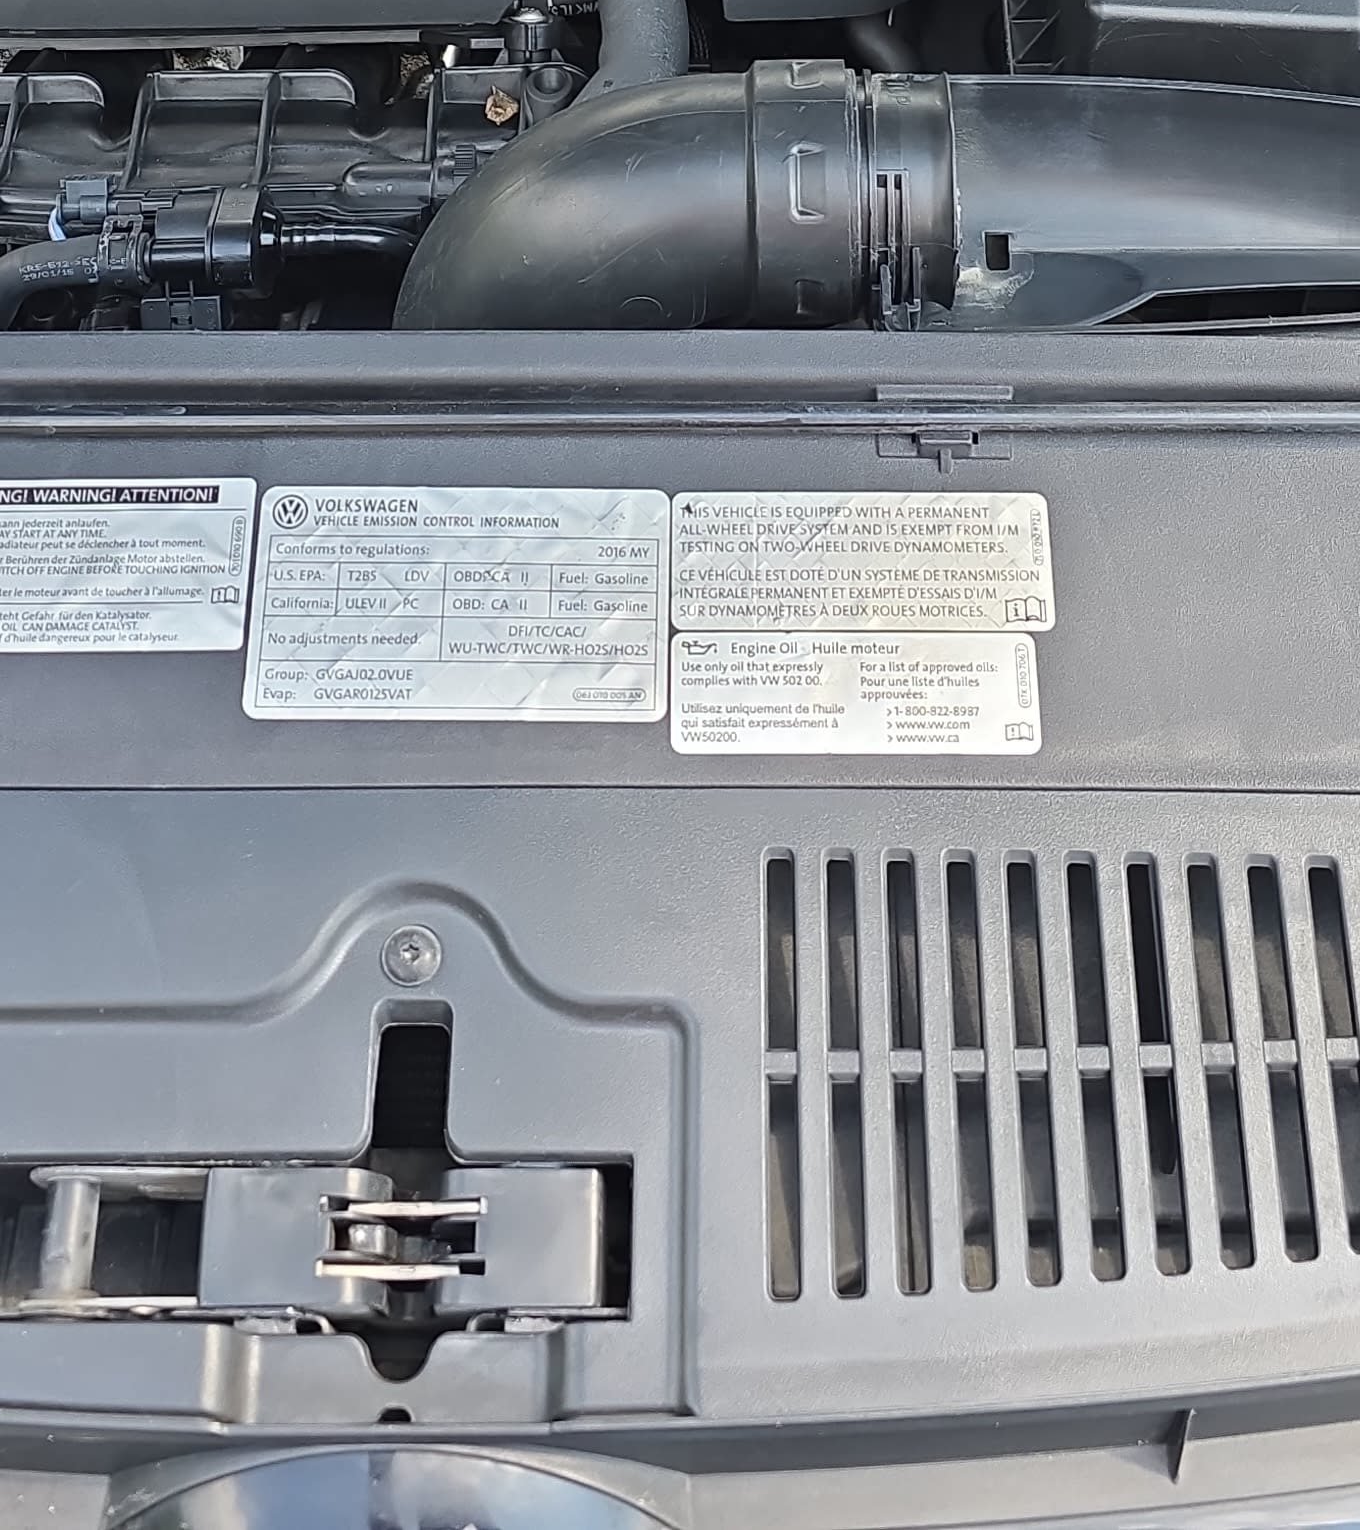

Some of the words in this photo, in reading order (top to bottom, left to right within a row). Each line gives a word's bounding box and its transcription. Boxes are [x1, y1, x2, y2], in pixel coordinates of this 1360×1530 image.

[33, 489, 116, 503] WARNING!
[119, 489, 213, 502] ATTENTION!
[315, 499, 418, 513] VOLKSWAGEN
[680, 506, 709, 518] THIS
[713, 506, 766, 518] VEHICLE
[771, 506, 782, 518] IS
[786, 506, 852, 520] EQUIPPED
[856, 507, 891, 518] WITH
[895, 507, 904, 518] A
[908, 507, 990, 518] PERMANENT
[314, 516, 359, 526] VEHICLE
[363, 516, 417, 527] EMISSION
[424, 516, 474, 528] CONTROL
[480, 518, 559, 529] INFORMATION
[13, 530, 40, 539] START
[43, 530, 56, 538] AT
[57, 529, 78, 538] ANY
[80, 529, 107, 538] TIME.
[680, 524, 753, 536] ALL-WHEEL
[757, 524, 795, 535] DRIVE
[800, 524, 848, 535] SYSTEM
[852, 524, 882, 536] AND
[886, 524, 897, 536] IS
[901, 524, 952, 536] EXEMPT
[956, 524, 993, 536] FROM
[997, 525, 1019, 536] I/M
[276, 543, 336, 555] Conforms
[340, 544, 352, 555] to
[355, 543, 430, 558] regulations:
[598, 546, 626, 558] 2016
[630, 547, 650, 559] MY
[680, 541, 734, 552] TESTING
[738, 541, 759, 552] ON
[763, 541, 848, 552] TWO-WHEEL
[851, 541, 891, 553] DRIVE
[894, 541, 1008, 553] DYNAMOMETERS.
[274, 570, 297, 581] U.S.
[300, 570, 325, 581] EPA:
[348, 570, 377, 581] T2B5
[405, 570, 429, 581] LDV
[559, 572, 588, 584] Fuel:
[595, 573, 649, 585] Gasoline
[680, 569, 695, 581] CE
[698, 567, 761, 581] VÉHICULE
[765, 570, 786, 581] EST
[790, 567, 825, 581] DOTÉ
[828, 569, 861, 581] D'UN
[923, 570, 941, 581] DE
[944, 570, 1040, 581] TRANSMISSION
[679, 585, 748, 599] INTÉGRALE
[751, 587, 829, 598] PERMANENT
[831, 587, 846, 598] ET
[849, 585, 905, 599] EXEMPTÉ
[908, 587, 961, 599] D'ESSAIS
[964, 587, 997, 599] D'I/M
[271, 597, 334, 610] California:
[345, 598, 376, 609] ULEV
[379, 598, 387, 609] II
[402, 598, 419, 610] PC
[453, 599, 485, 610] OBD:
[491, 599, 509, 610] CA
[519, 599, 527, 611] II
[558, 599, 587, 611] Fuel:
[593, 600, 648, 612] Gasoline
[680, 605, 705, 617] SUR
[709, 603, 816, 617] DYNAMOMÈTRES
[819, 603, 830, 616] À
[833, 605, 868, 617] DEUX
[872, 605, 916, 617] ROUES
[919, 605, 987, 617] MOTRICES.
[508, 625, 587, 638] DFI/TC/CAC/
[268, 633, 286, 645] No
[289, 633, 368, 647] adjustments
[371, 633, 421, 645] needed.
[449, 642, 648, 656] WU-TWC/TWC/WR-HO2S/HO2S
[731, 642, 776, 657] Engine
[780, 642, 797, 654] Oil
[812, 642, 847, 654] Huile
[851, 642, 900, 655] moteur
[681, 662, 701, 672] Use
[705, 662, 728, 674] only
[731, 662, 744, 672] oil
[747, 662, 769, 672] that
[772, 662, 823, 675] expressly
[860, 662, 877, 672] For
[879, 664, 886, 672] a
[889, 662, 905, 672] list
[908, 662, 920, 672] of
[923, 662, 973, 675] approved
[976, 662, 998, 672] oils:
[265, 669, 308, 682] Group:
[316, 669, 413, 680] GVGAJ02.0VUE
[681, 676, 730, 688] complies
[733, 676, 758, 686] with
[760, 676, 780, 686] VW
[783, 676, 802, 686] 502
[806, 676, 822, 686] 00.
[860, 677, 885, 687] Pour
[888, 678, 908, 687] une
[912, 677, 935, 687] liste
[937, 677, 980, 687] d'huiles
[263, 688, 296, 701] Evap:
[314, 688, 412, 700] GVGAR0125VAT
[860, 689, 928, 702] approuvées:
[682, 703, 722, 714] Utilisez
[725, 703, 792, 716] uniquement
[795, 703, 809, 714] de
[812, 703, 845, 714] l'huile
[681, 718, 698, 730] qui
[702, 717, 745, 728] satisfait
[748, 717, 828, 730] expressément
[831, 717, 838, 728] à
[896, 722, 970, 730] www.vw.com
[681, 731, 740, 742] VW50200.
